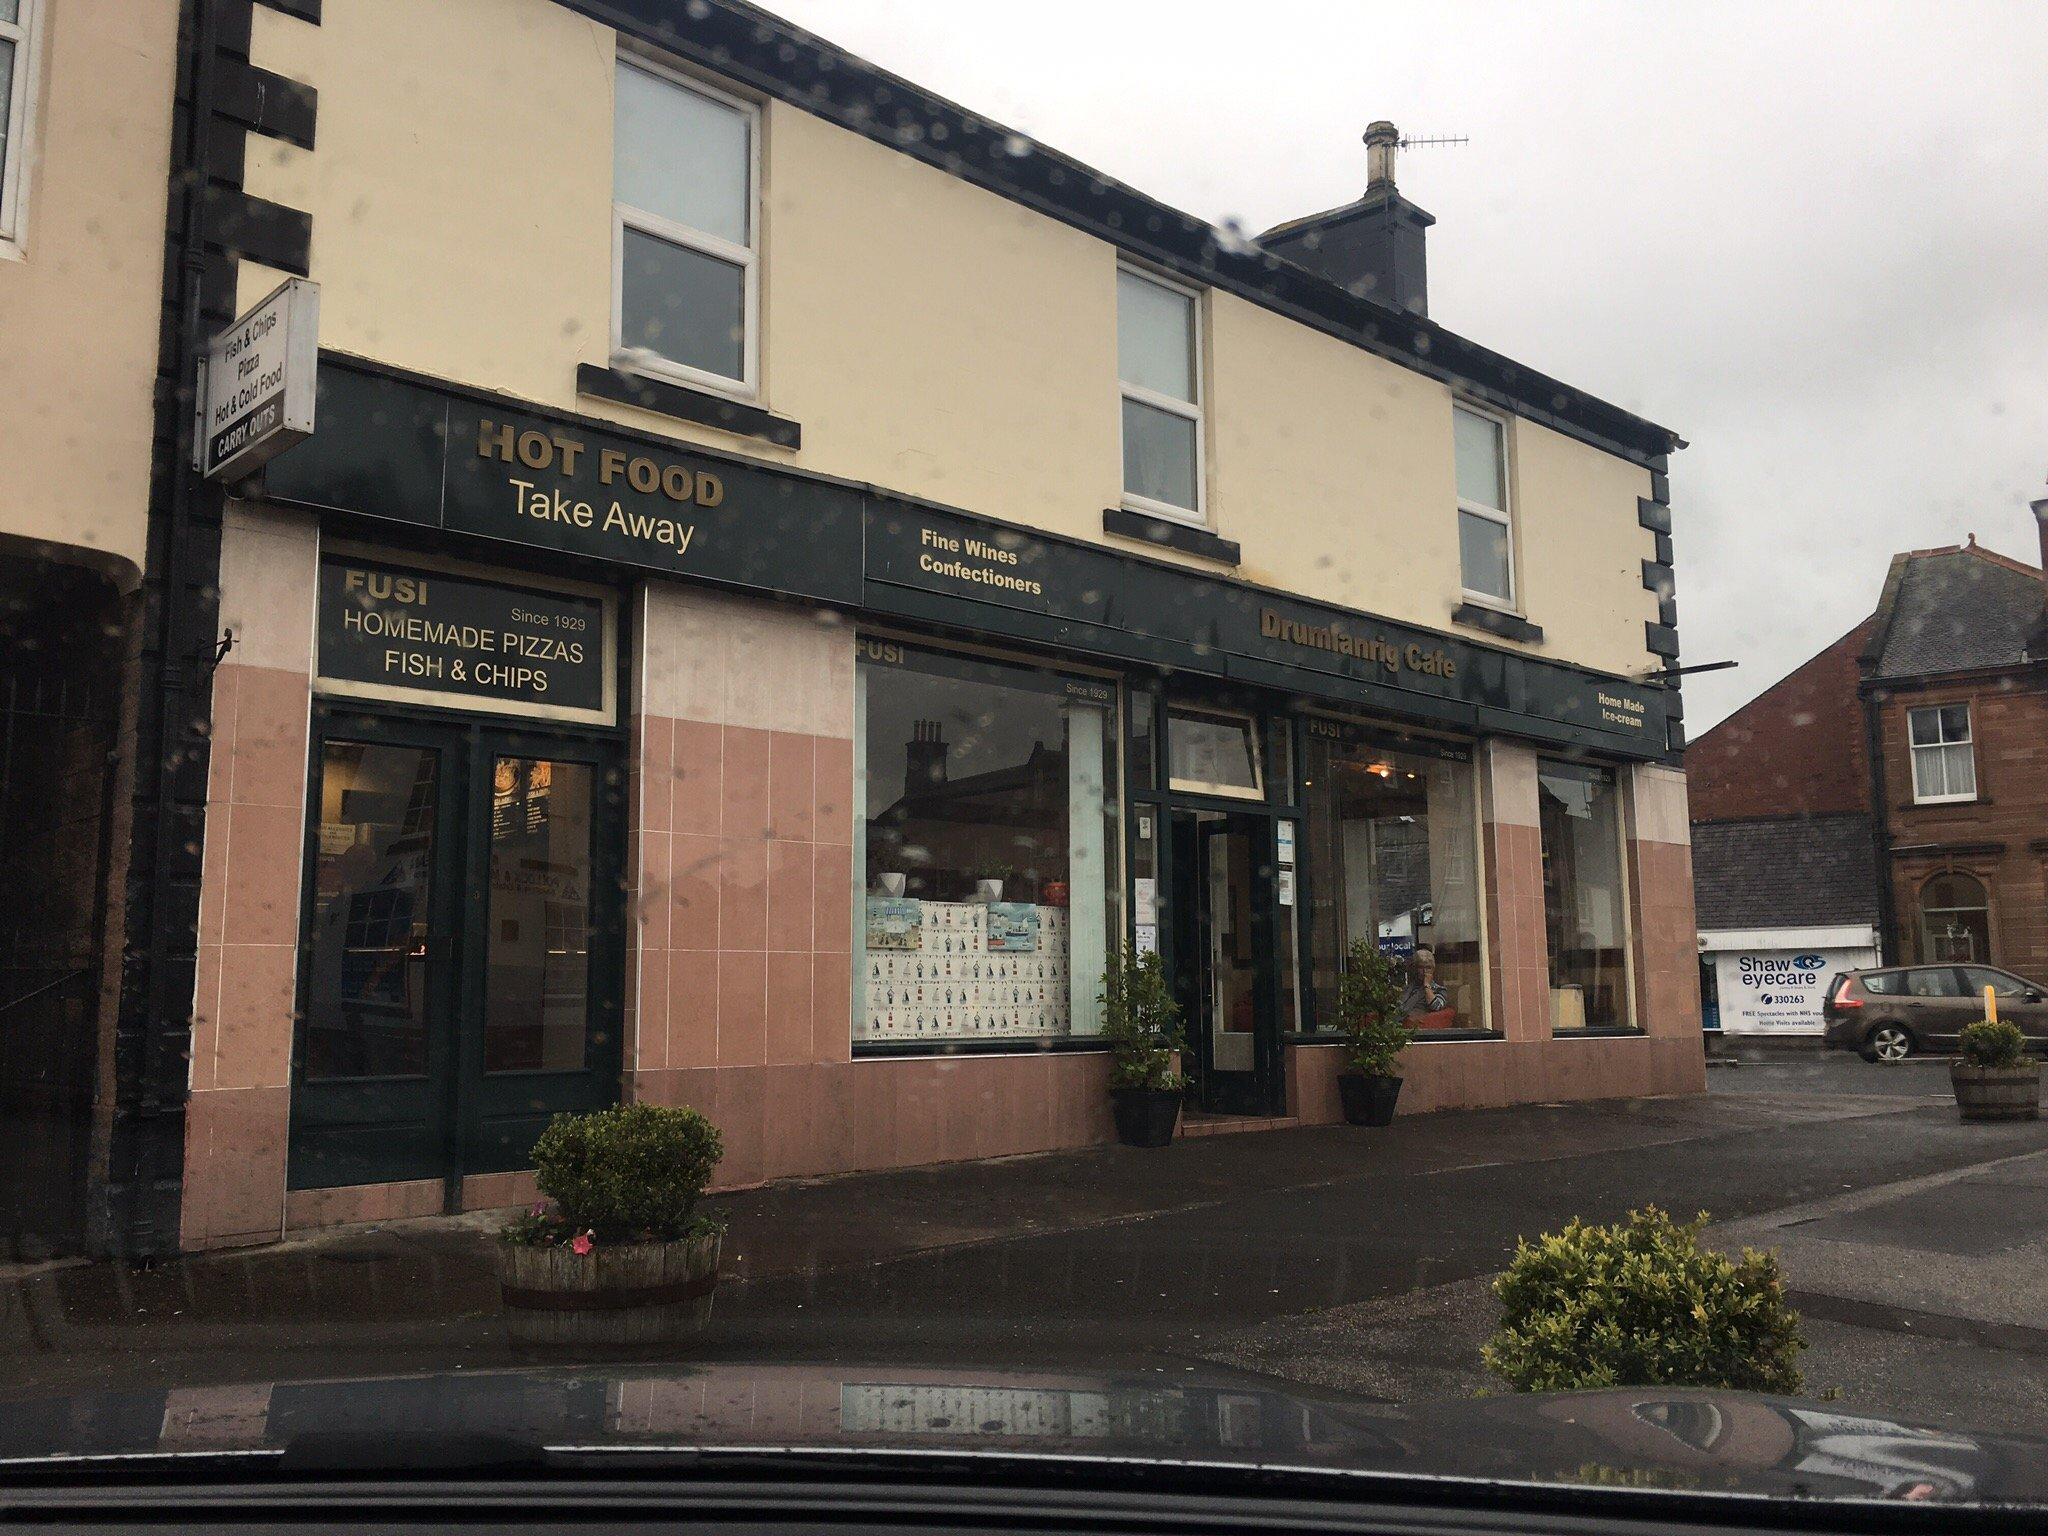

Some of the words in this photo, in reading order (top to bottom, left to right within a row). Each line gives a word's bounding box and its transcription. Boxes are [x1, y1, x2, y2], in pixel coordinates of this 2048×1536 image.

[224, 335, 242, 363] Fish
[243, 328, 251, 348] &
[252, 311, 277, 341] Chips
[237, 353, 260, 381] Pizza
[215, 404, 229, 426] Hot
[230, 395, 237, 415] &
[238, 378, 258, 410] Cold
[259, 362, 283, 395] Food
[217, 422, 249, 458] CARRY
[249, 403, 276, 438] OUTS
[477, 418, 585, 477] HOT
[599, 448, 724, 508] FOOD
[509, 478, 594, 528] Take
[602, 501, 695, 555] Away
[921, 528, 960, 553] Fine
[964, 539, 1018, 565] Wines
[345, 568, 427, 606] FUSI
[919, 554, 1042, 595] Confectioners
[511, 607, 549, 626] Since
[554, 614, 586, 632] 1929
[344, 608, 495, 652] HOMEMADE
[503, 632, 584, 664] PIZZAS
[855, 638, 904, 664] FUSI
[384, 649, 443, 679] FISH
[450, 659, 467, 682] &
[474, 662, 548, 692] CHIPS
[1403, 642, 1457, 679] Cafe
[1066, 683, 1088, 696] Since
[1090, 687, 1108, 700] 1929
[1598, 692, 1622, 708] Home
[1623, 698, 1645, 714] Made
[1310, 719, 1340, 738] FUSI
[1602, 708, 1642, 728] Ice-cream
[1391, 941, 1411, 950] local
[1739, 956, 1791, 972] Shaw
[1742, 972, 1816, 989] eyecare
[1774, 995, 1805, 1004] 330263
